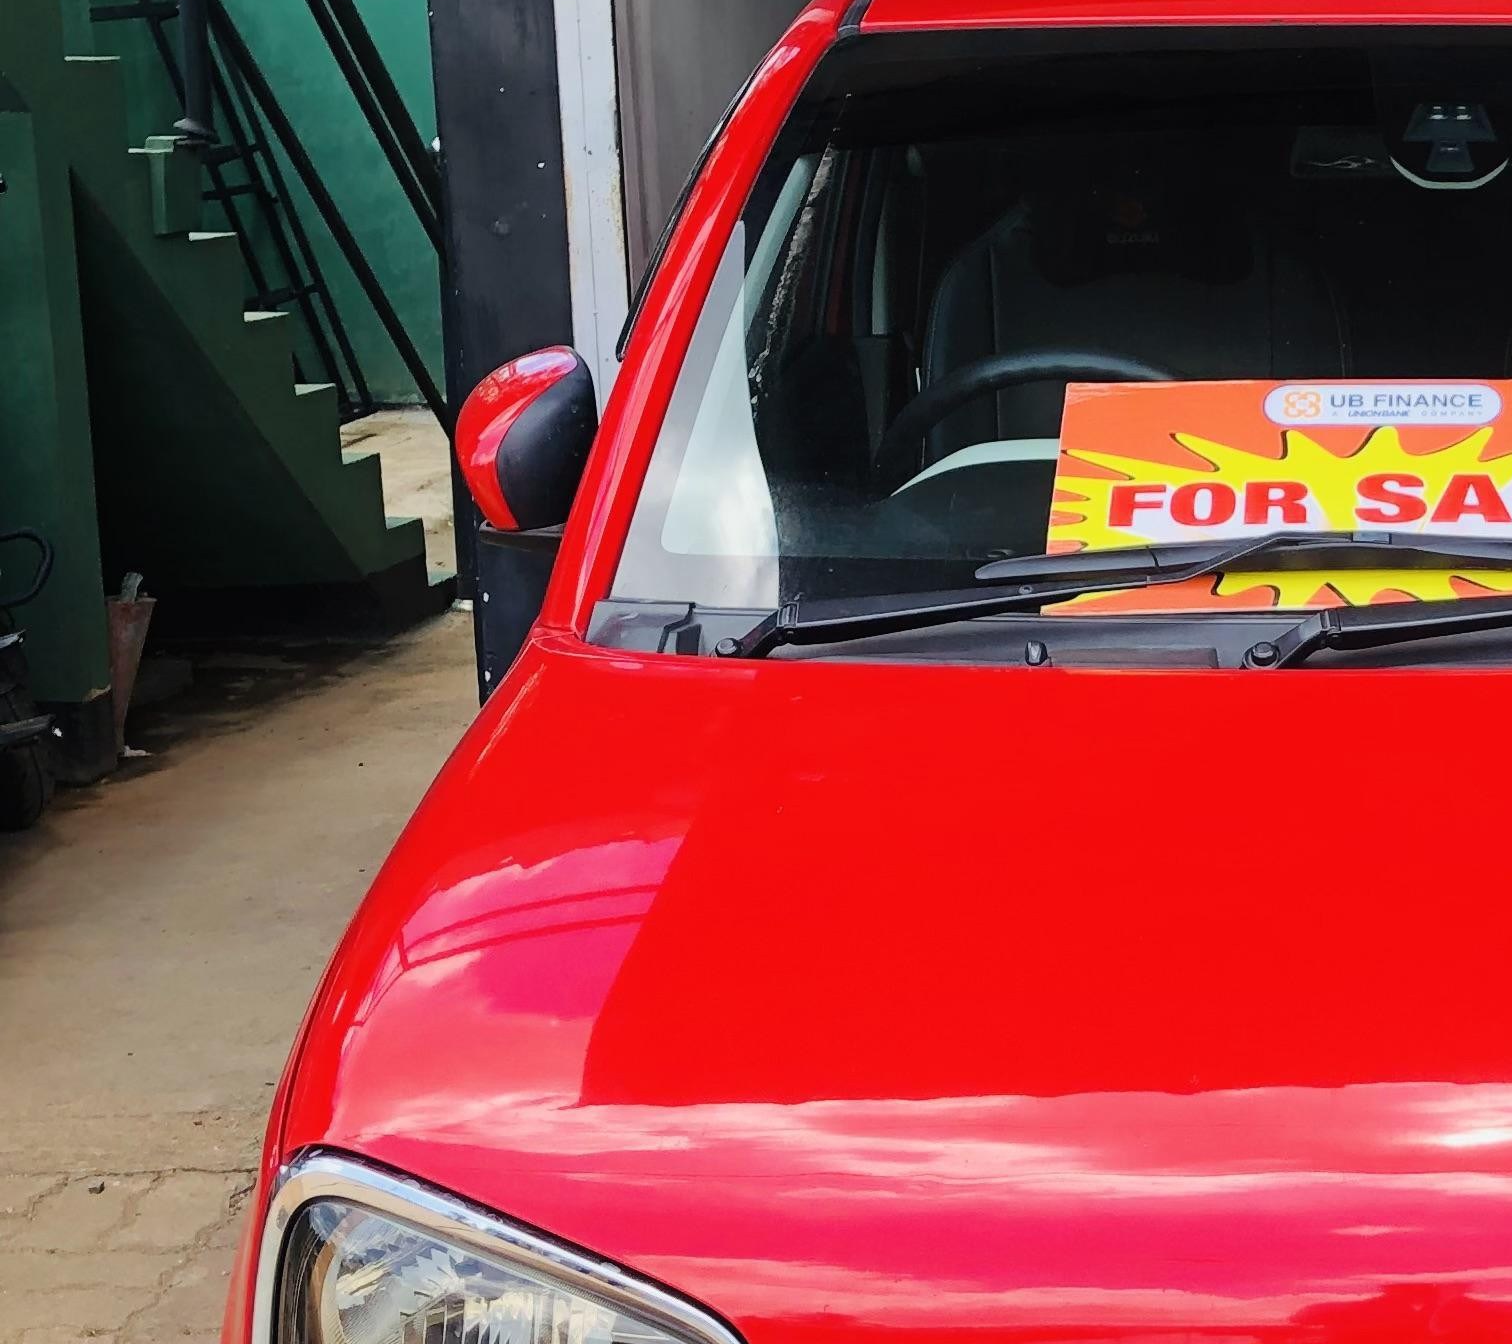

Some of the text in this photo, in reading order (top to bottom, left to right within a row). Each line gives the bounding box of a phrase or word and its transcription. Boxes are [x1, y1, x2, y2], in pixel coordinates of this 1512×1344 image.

[1329, 394, 1483, 408] UB FINANCE
[1107, 481, 1311, 527] FOR
